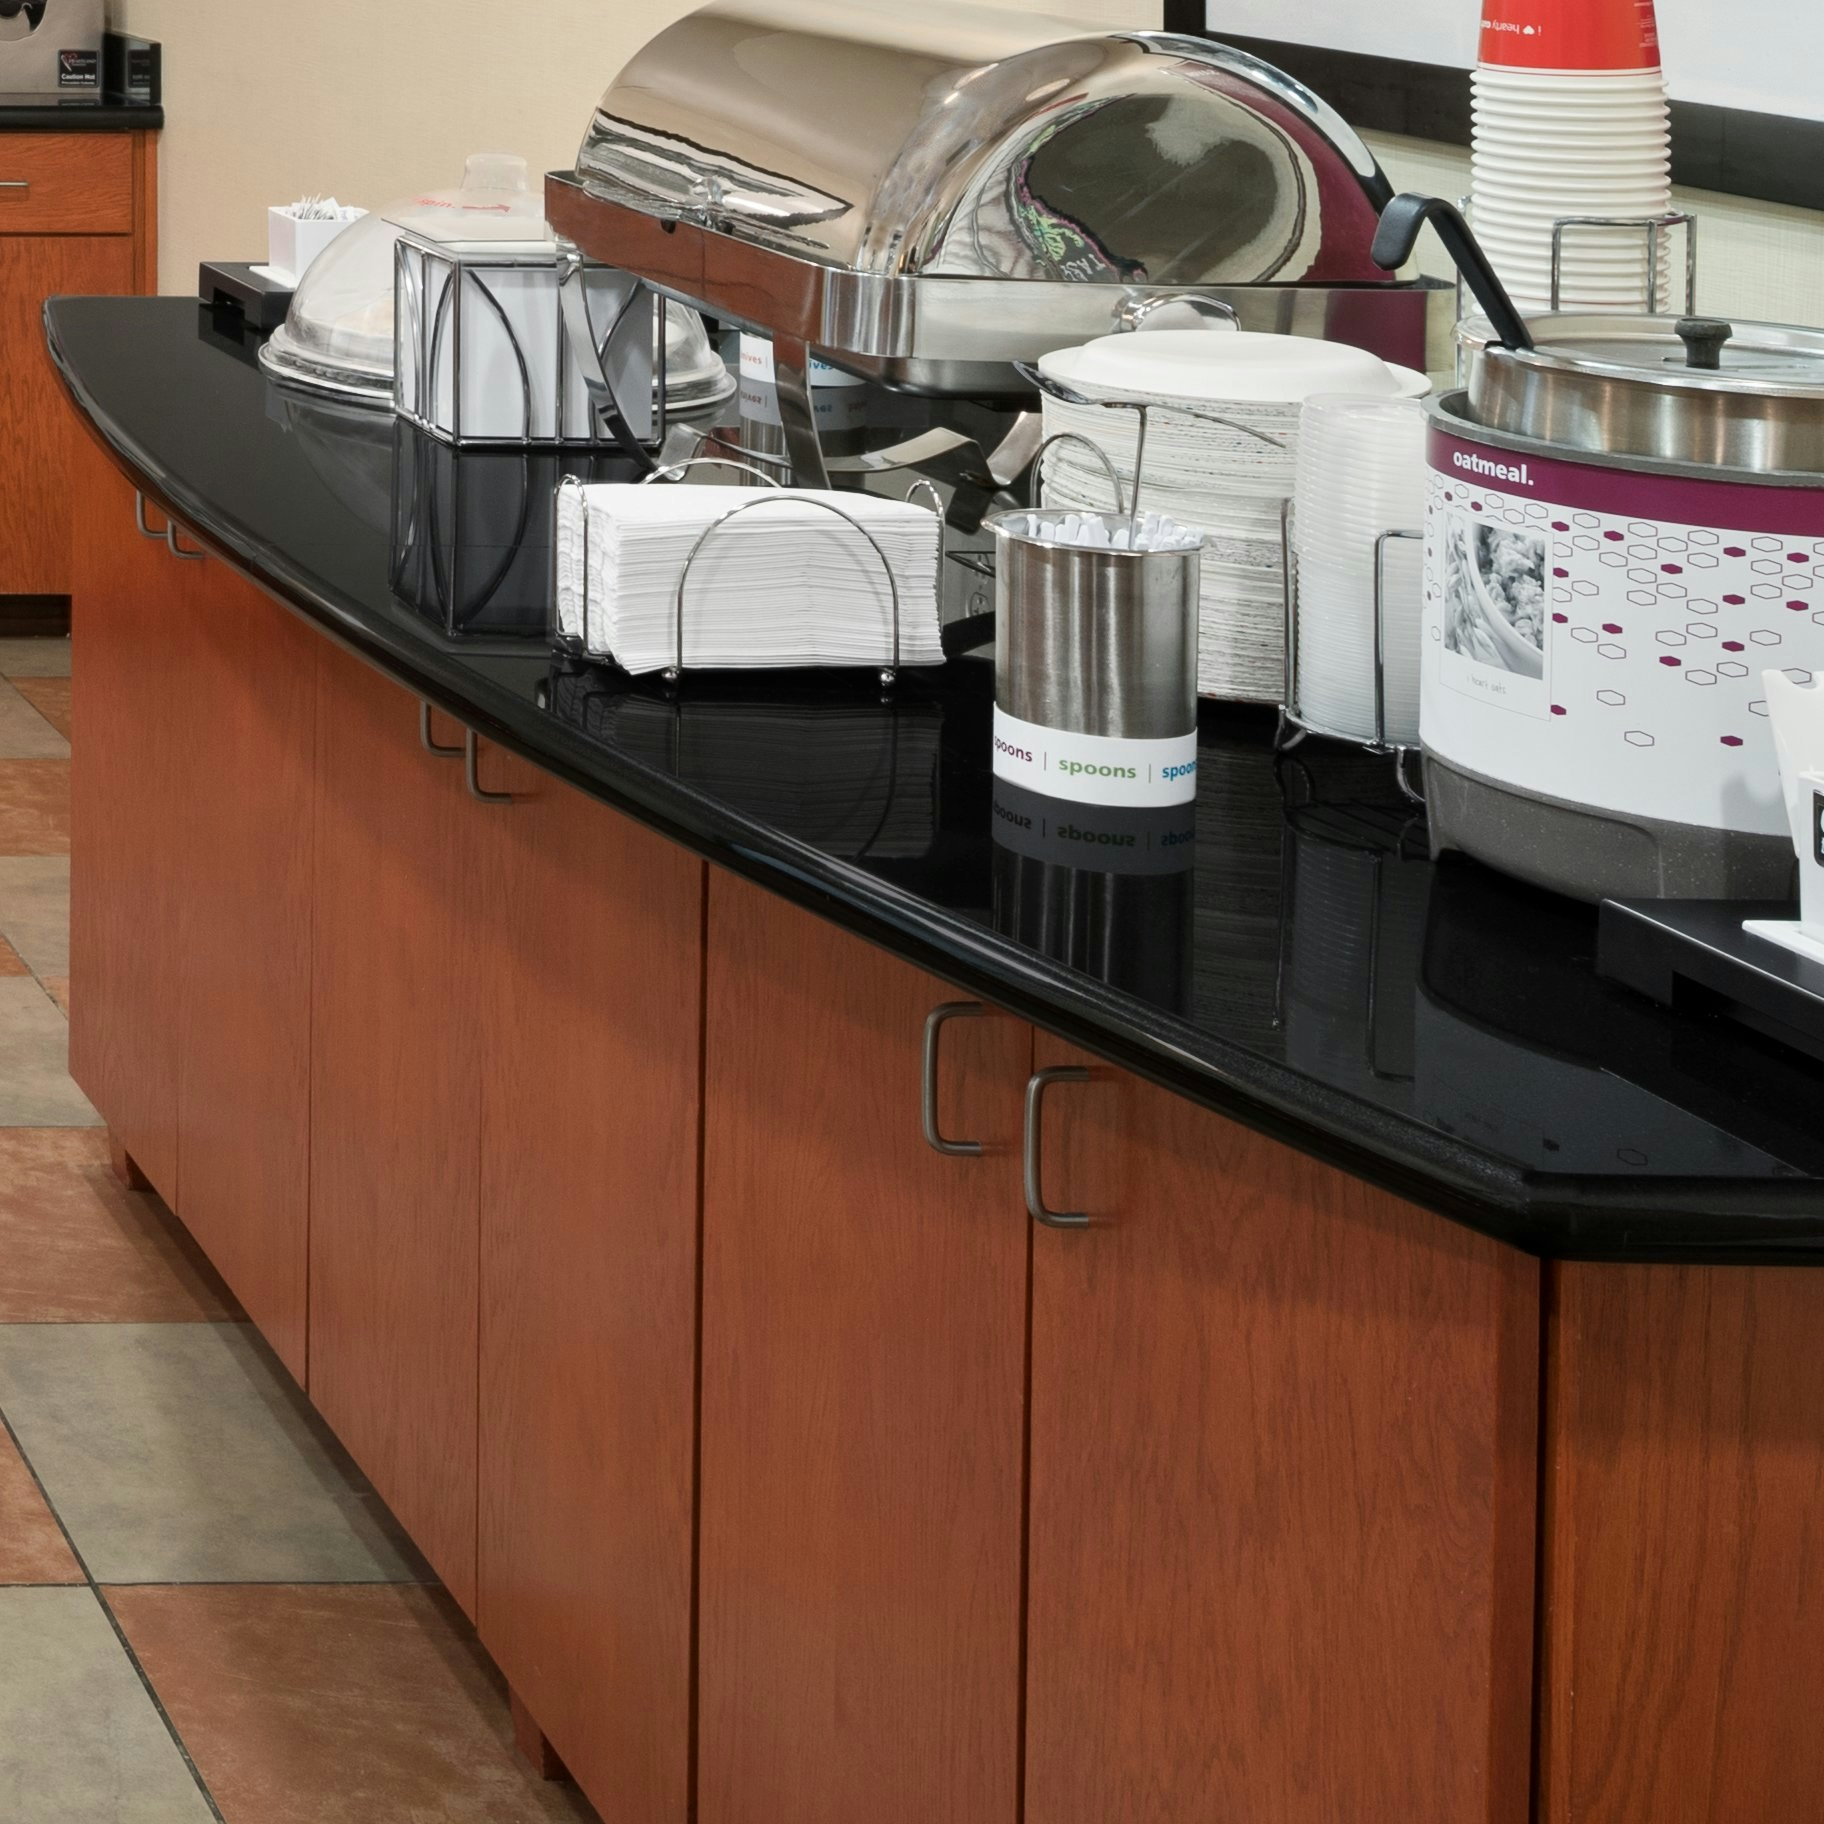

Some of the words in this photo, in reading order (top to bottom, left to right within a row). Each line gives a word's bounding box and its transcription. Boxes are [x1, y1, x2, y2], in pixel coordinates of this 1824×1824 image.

[1453, 451, 1534, 486] oatmeal.
[1058, 759, 1137, 780] spoons
[1162, 760, 1197, 782] spoon
